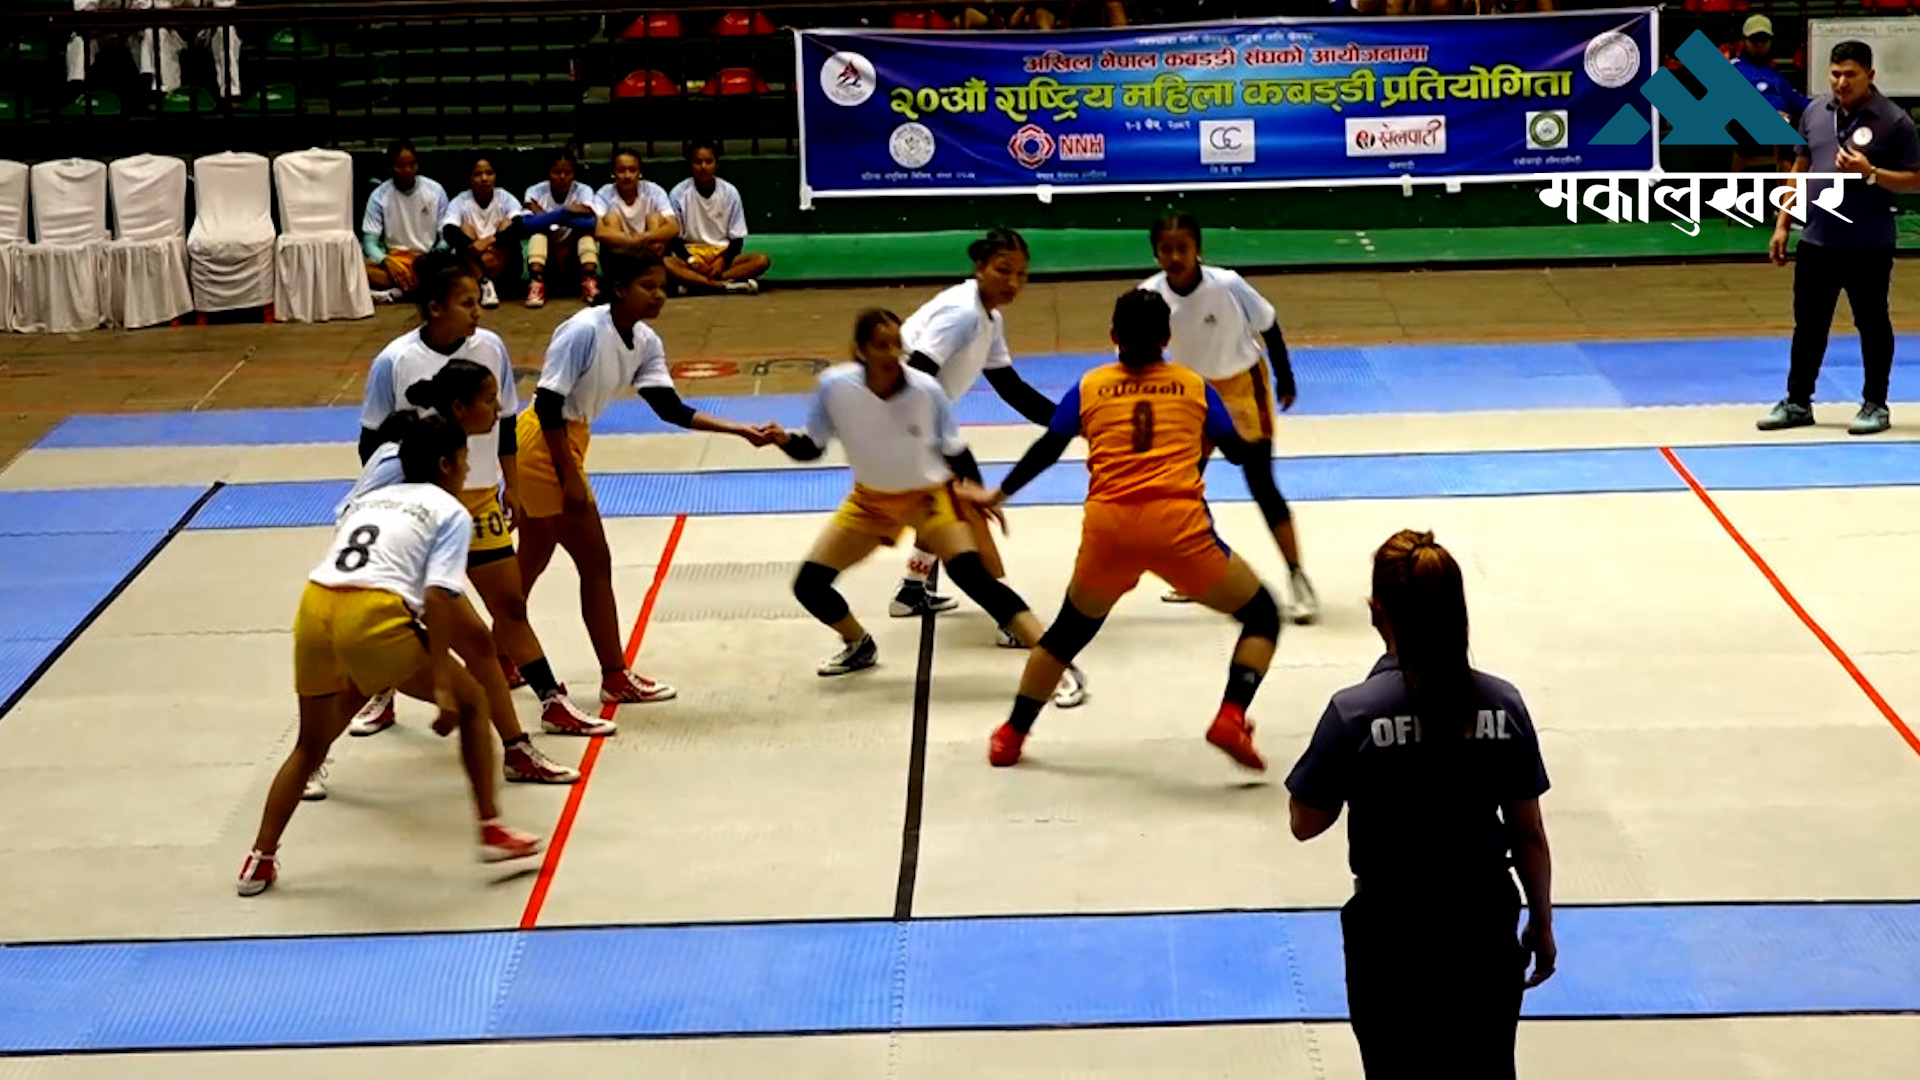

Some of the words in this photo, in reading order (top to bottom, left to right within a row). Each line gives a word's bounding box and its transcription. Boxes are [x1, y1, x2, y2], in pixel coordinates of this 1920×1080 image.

[1024, 51, 1092, 73] अखिल
[1100, 51, 1157, 71] नेपाल
[1243, 45, 1304, 66] संघको
[1311, 44, 1429, 64] आयोजनामा
[1122, 73, 1236, 114] महिला
[1381, 65, 1572, 108] प्रतियोगिता
[1059, 133, 1105, 160] NNH
[335, 524, 380, 573] 8
